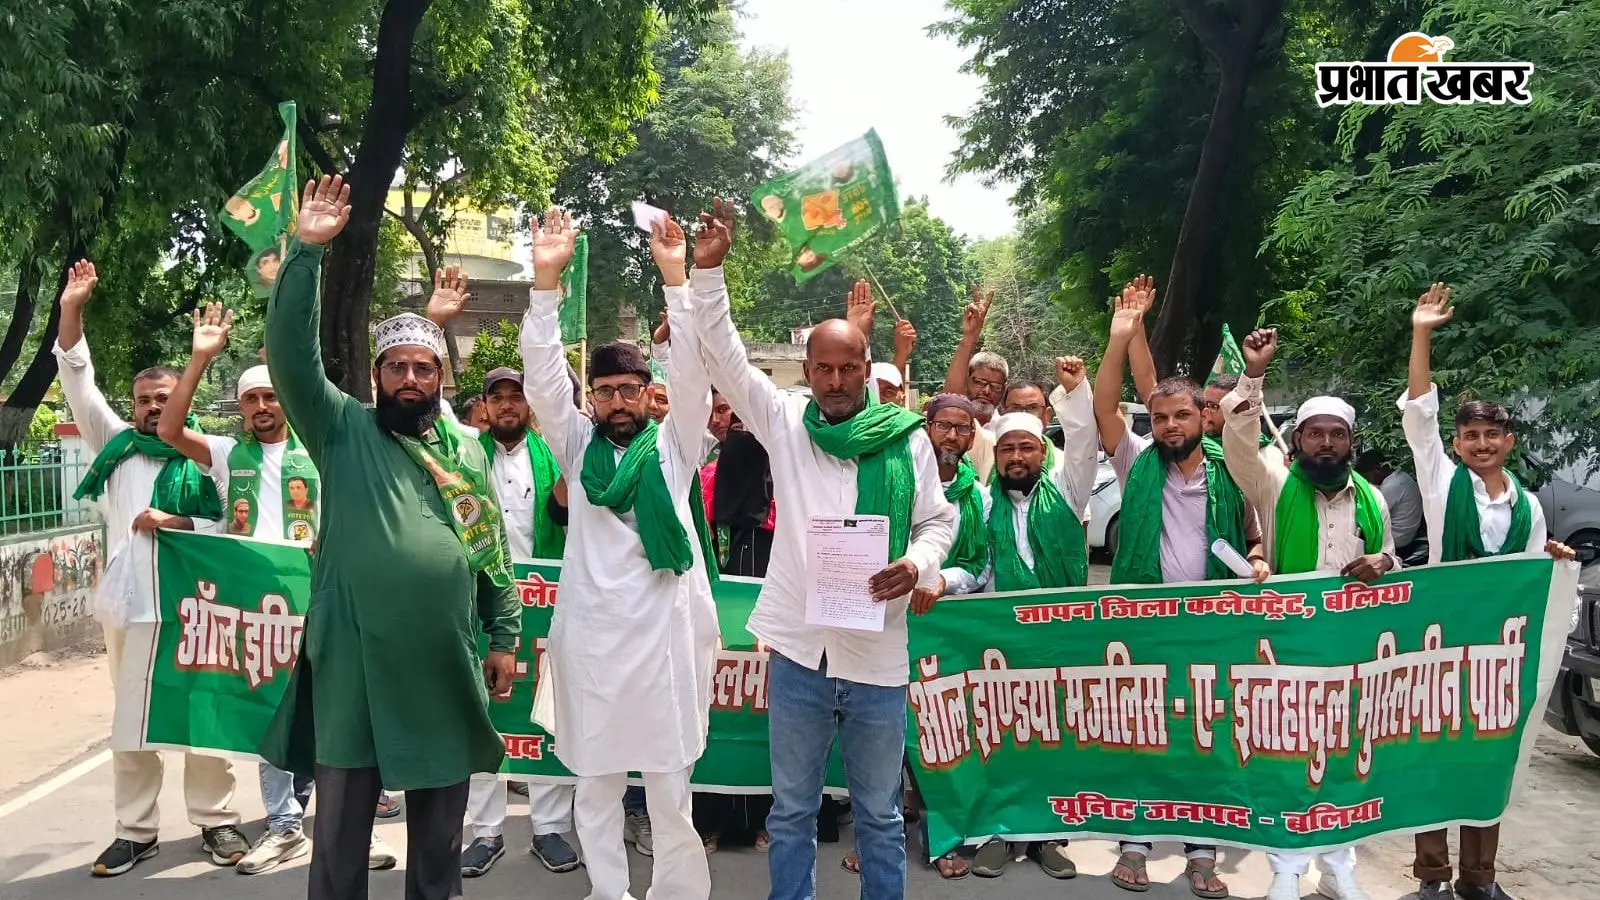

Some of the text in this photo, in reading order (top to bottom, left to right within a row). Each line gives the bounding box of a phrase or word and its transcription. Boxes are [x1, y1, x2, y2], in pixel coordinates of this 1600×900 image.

[463, 521, 488, 541] KITE
[469, 536, 492, 555] AIMIM
[1014, 582, 1412, 624] ज्ञापन जिला कलेक्ट्रेट, बलिया
[177, 580, 240, 671] ऑल
[909, 654, 971, 765] ऑल
[967, 648, 1060, 759] इण्डिया
[1060, 641, 1168, 746] मजलिस
[1468, 615, 1527, 731] पार्टी
[1048, 792, 1138, 826] यूनिट
[1140, 799, 1252, 829] जनपद
[1282, 797, 1383, 834] बलिया
